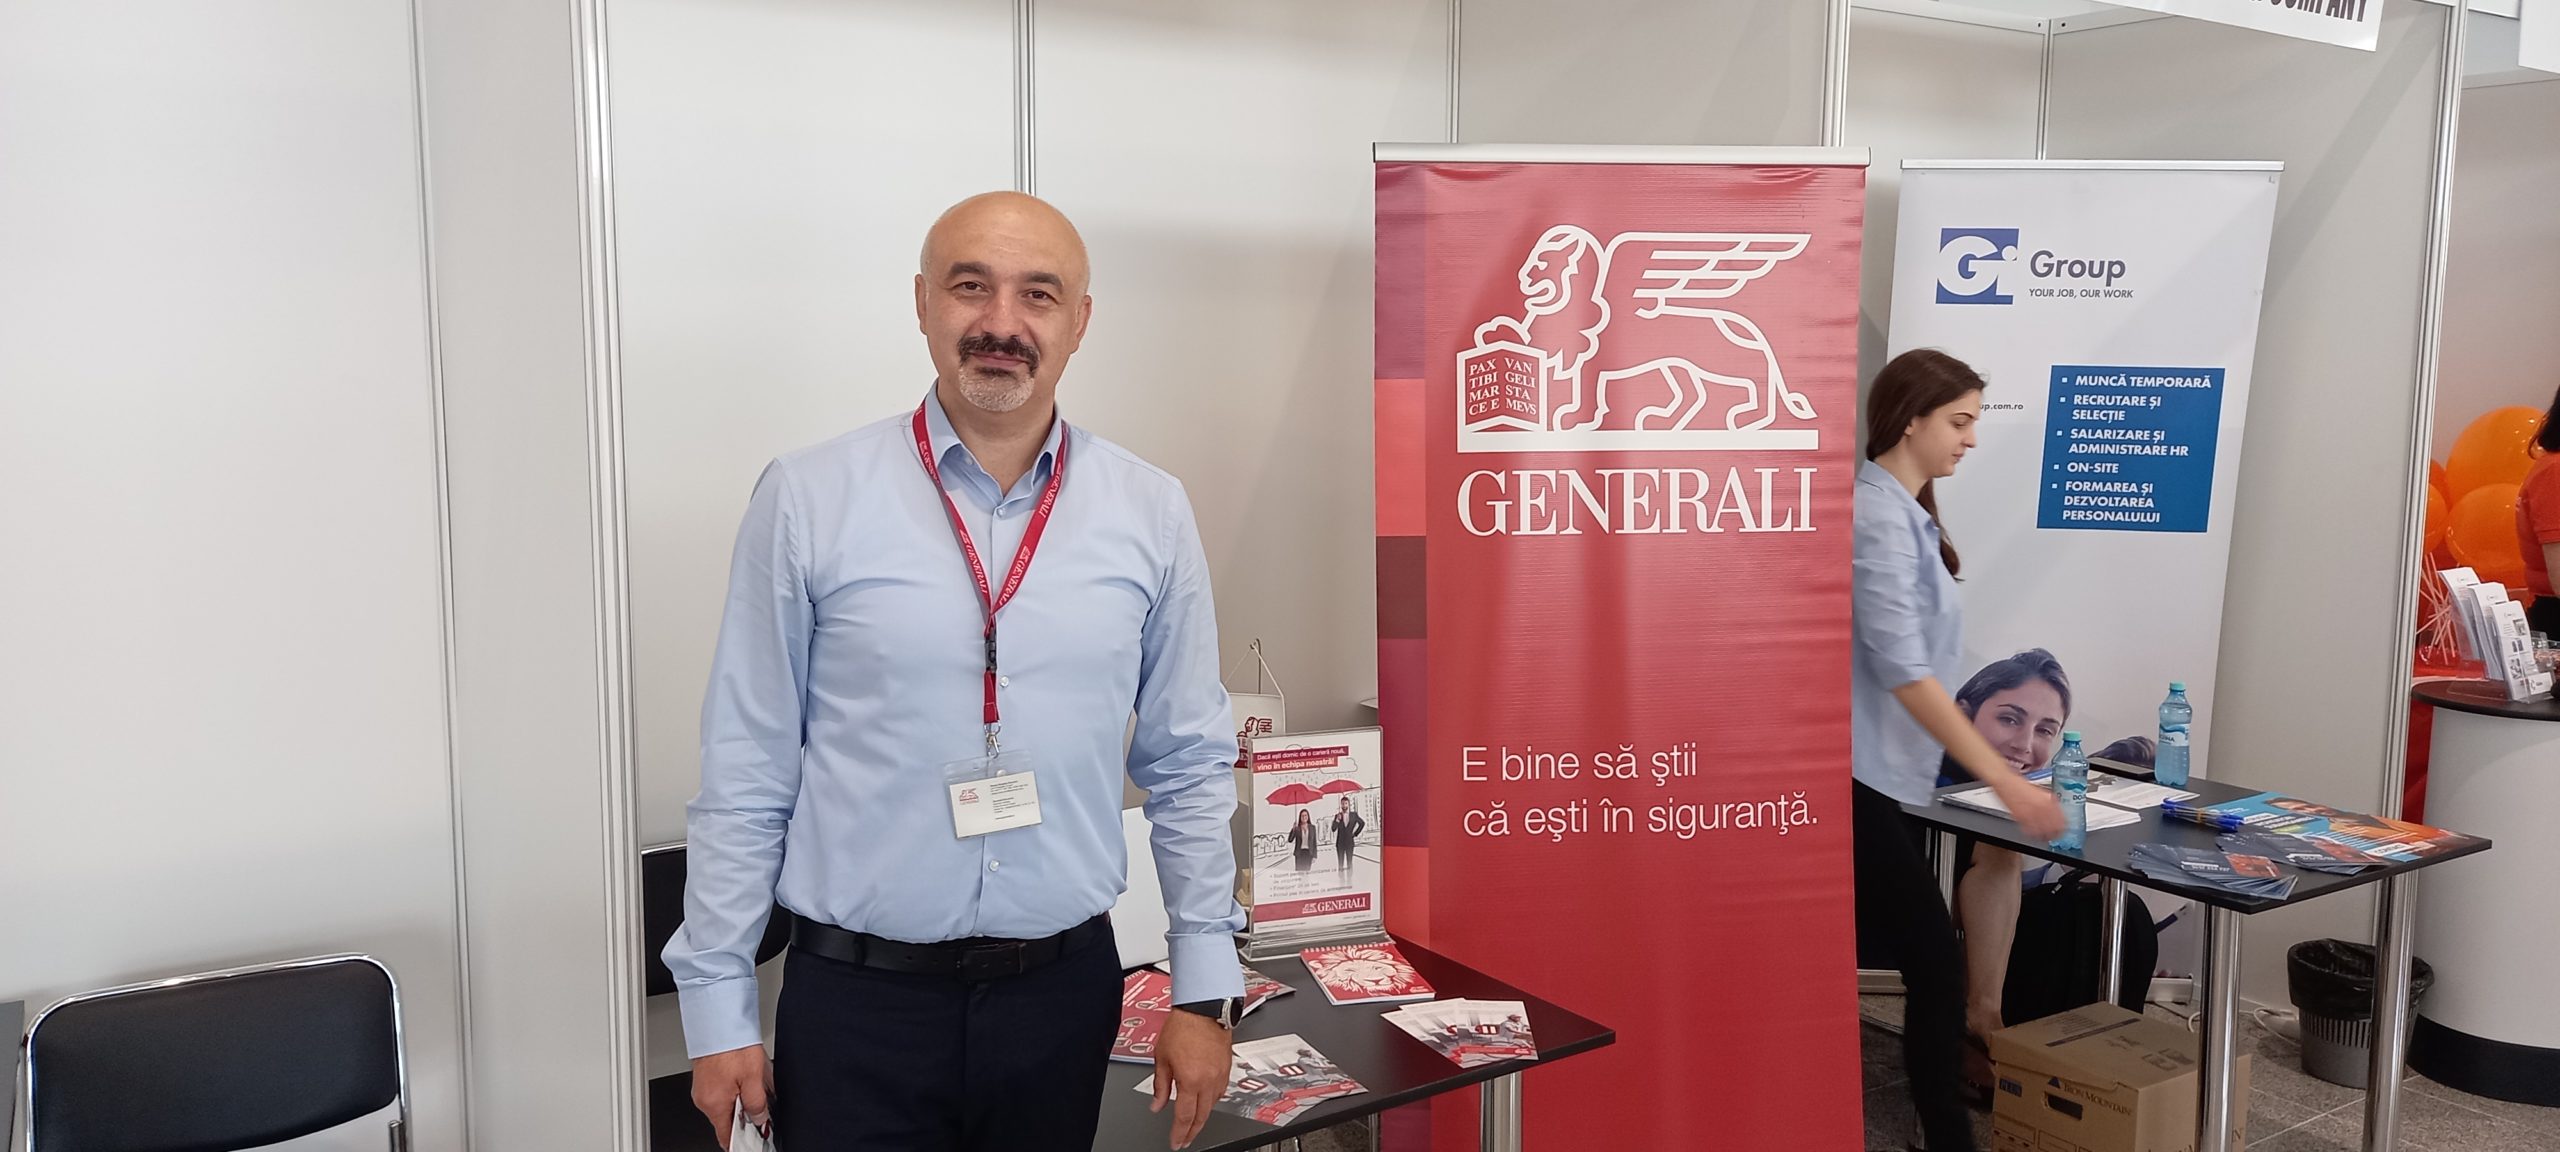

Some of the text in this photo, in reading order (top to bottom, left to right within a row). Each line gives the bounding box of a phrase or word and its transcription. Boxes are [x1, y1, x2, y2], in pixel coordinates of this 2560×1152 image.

[2030, 249, 2126, 287] Group
[2029, 288, 2134, 299] YOUR JOB, OUR WORK
[1469, 358, 1497, 376] PAX
[1504, 357, 1532, 374] VAN
[1469, 371, 1498, 389] TIBI
[1504, 371, 1536, 388] GELI
[2075, 373, 2212, 389] MUNCĂ TEMPORARĂ
[1469, 385, 1500, 403] MAR
[1505, 384, 1531, 401] STA
[1506, 398, 1537, 415] MEVS
[2073, 394, 2162, 410] RECRUTARE ȘI
[2072, 409, 2126, 424] SELECȚIE
[2070, 428, 2165, 444] SALARIZARE ȘI
[2068, 442, 2189, 457] ADMINISTRARE HR
[2067, 462, 2119, 474] ON-SITE
[2065, 480, 2154, 497] FORMAREA ȘI
[1457, 466, 1818, 537] GENERALI
[2063, 496, 2155, 508] DEZVOLTAREA
[2062, 510, 2161, 523] PERSONALULUI
[1282, 760, 1304, 769] echipa
[1463, 746, 1488, 781] E
[1501, 745, 1580, 781] bine
[1593, 743, 1639, 779] să
[1463, 800, 1510, 836] că
[1599, 797, 1634, 833] în
[1318, 897, 1366, 912] GENERALI
